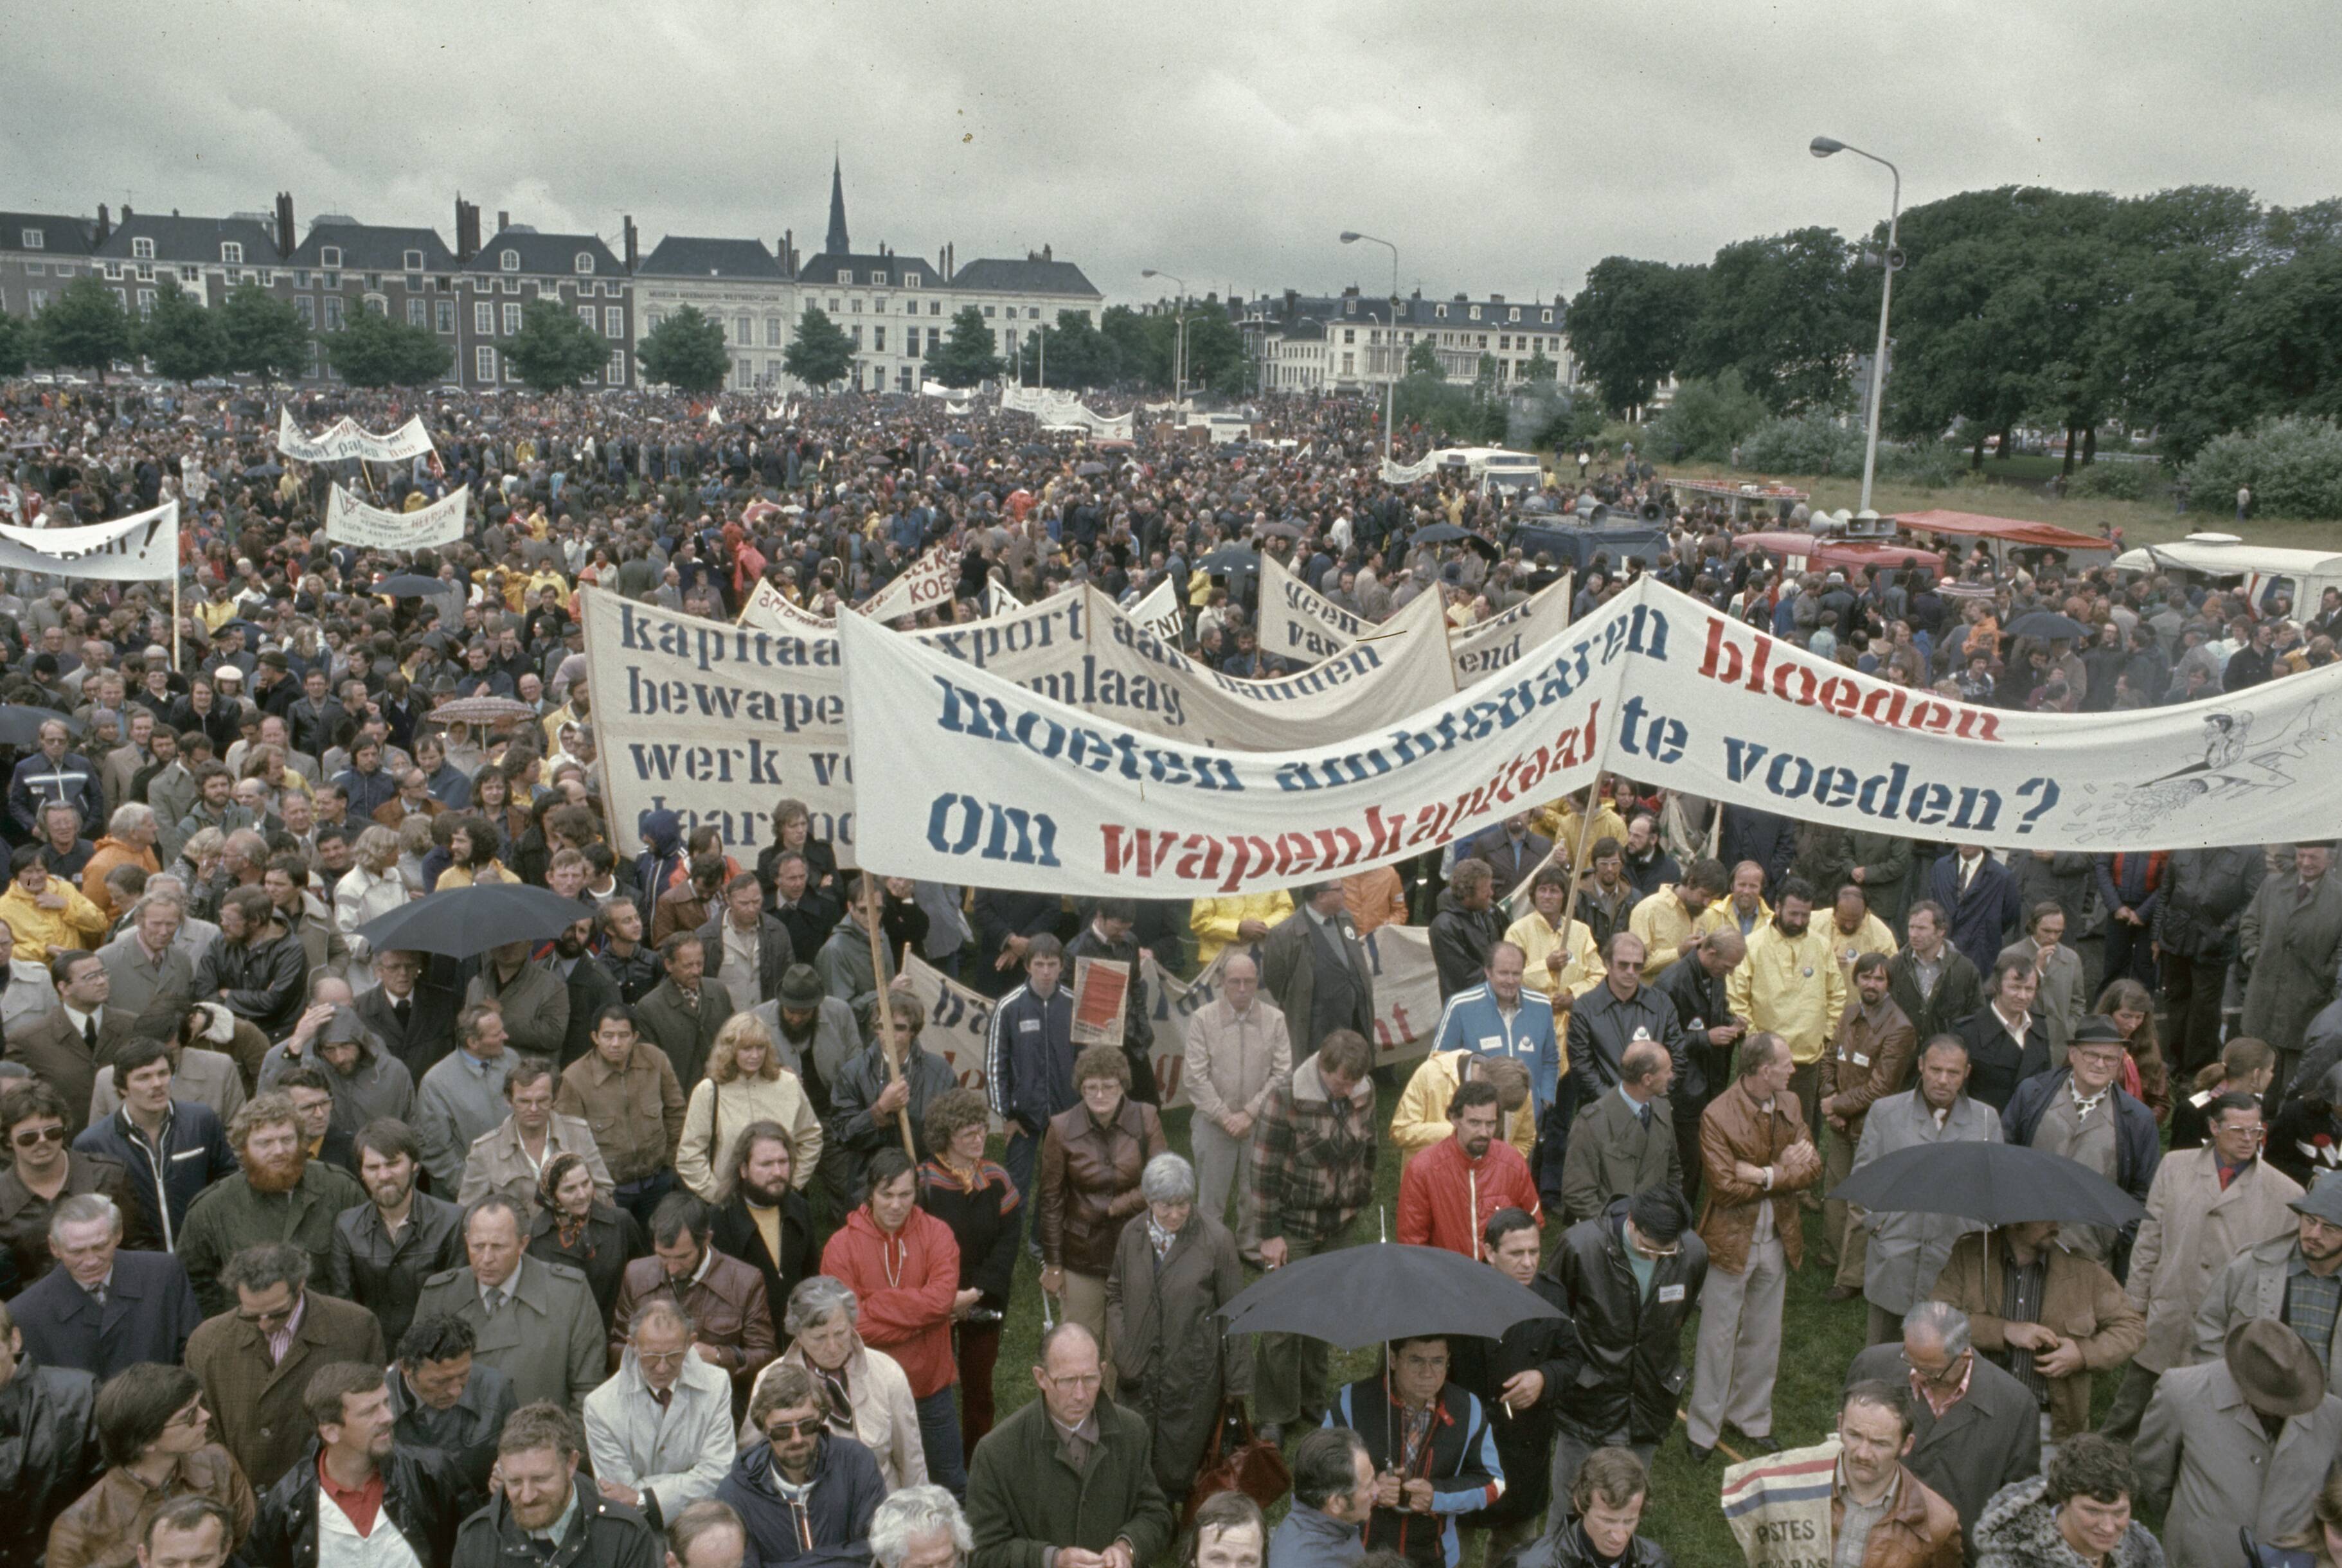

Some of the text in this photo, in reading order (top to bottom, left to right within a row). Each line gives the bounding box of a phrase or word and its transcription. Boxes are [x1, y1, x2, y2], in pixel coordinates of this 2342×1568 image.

[909, 573, 952, 605] KOE
[1286, 581, 1359, 636] geen
[620, 603, 841, 671] kapitaa
[1111, 616, 1195, 673] aan
[1143, 608, 1181, 637] ENT
[1454, 633, 1523, 673] end
[626, 655, 1185, 732] bewape mlaag
[933, 604, 2004, 792] moeten ambtenaren bloeden
[629, 738, 782, 785] werk
[927, 695, 2060, 892] om wapenkapitaal te voeden?
[1756, 1519, 1815, 1544] PSTES
